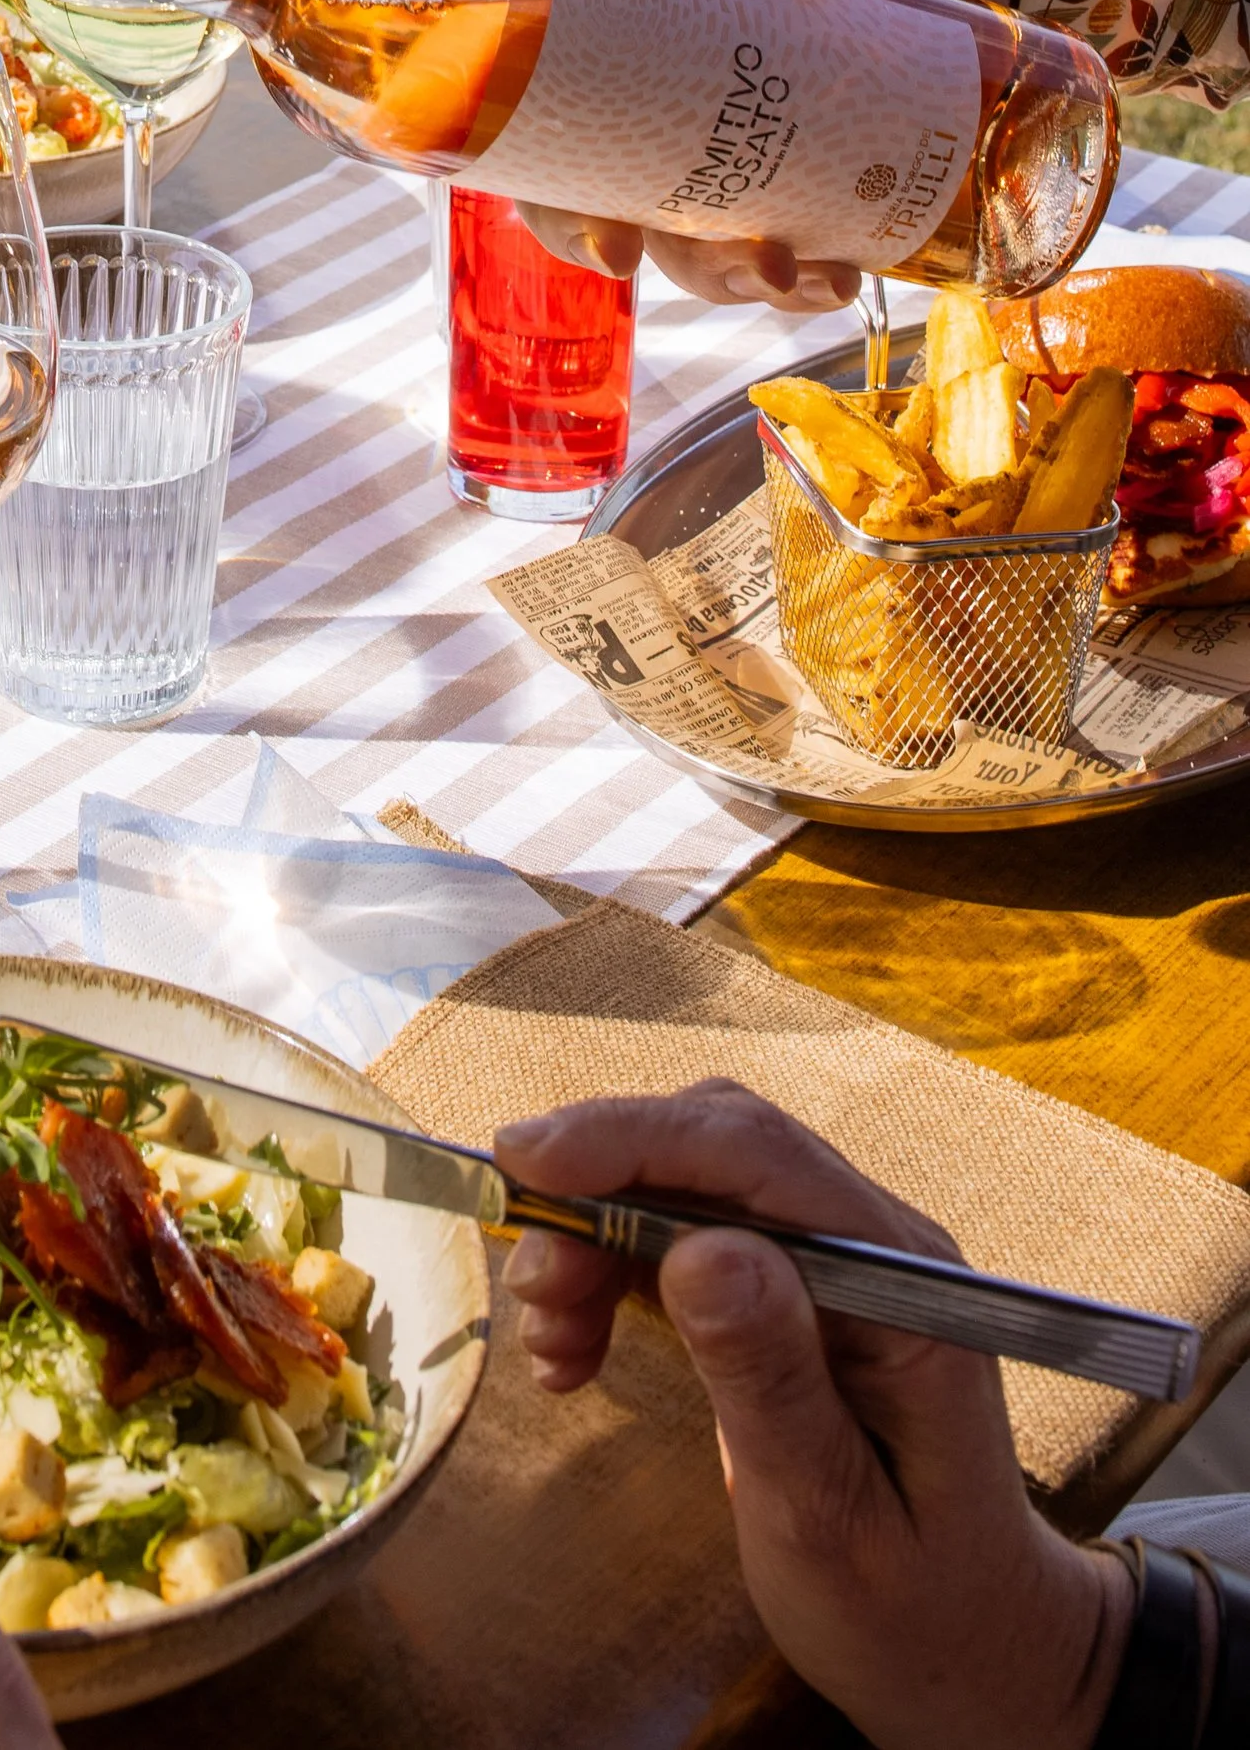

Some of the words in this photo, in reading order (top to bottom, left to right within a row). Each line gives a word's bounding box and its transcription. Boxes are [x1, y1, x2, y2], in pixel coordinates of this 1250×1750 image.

[656, 43, 763, 213] PRIMITIVO
[701, 75, 790, 210] ROSATO
[780, 121, 799, 149] Italy
[774, 147, 787, 161] in
[757, 159, 781, 190] Made
[878, 130, 959, 241] TRULLI
[900, 150, 925, 194] BORGO
[740, 578, 768, 597] 10
[628, 620, 674, 645] Chickens
